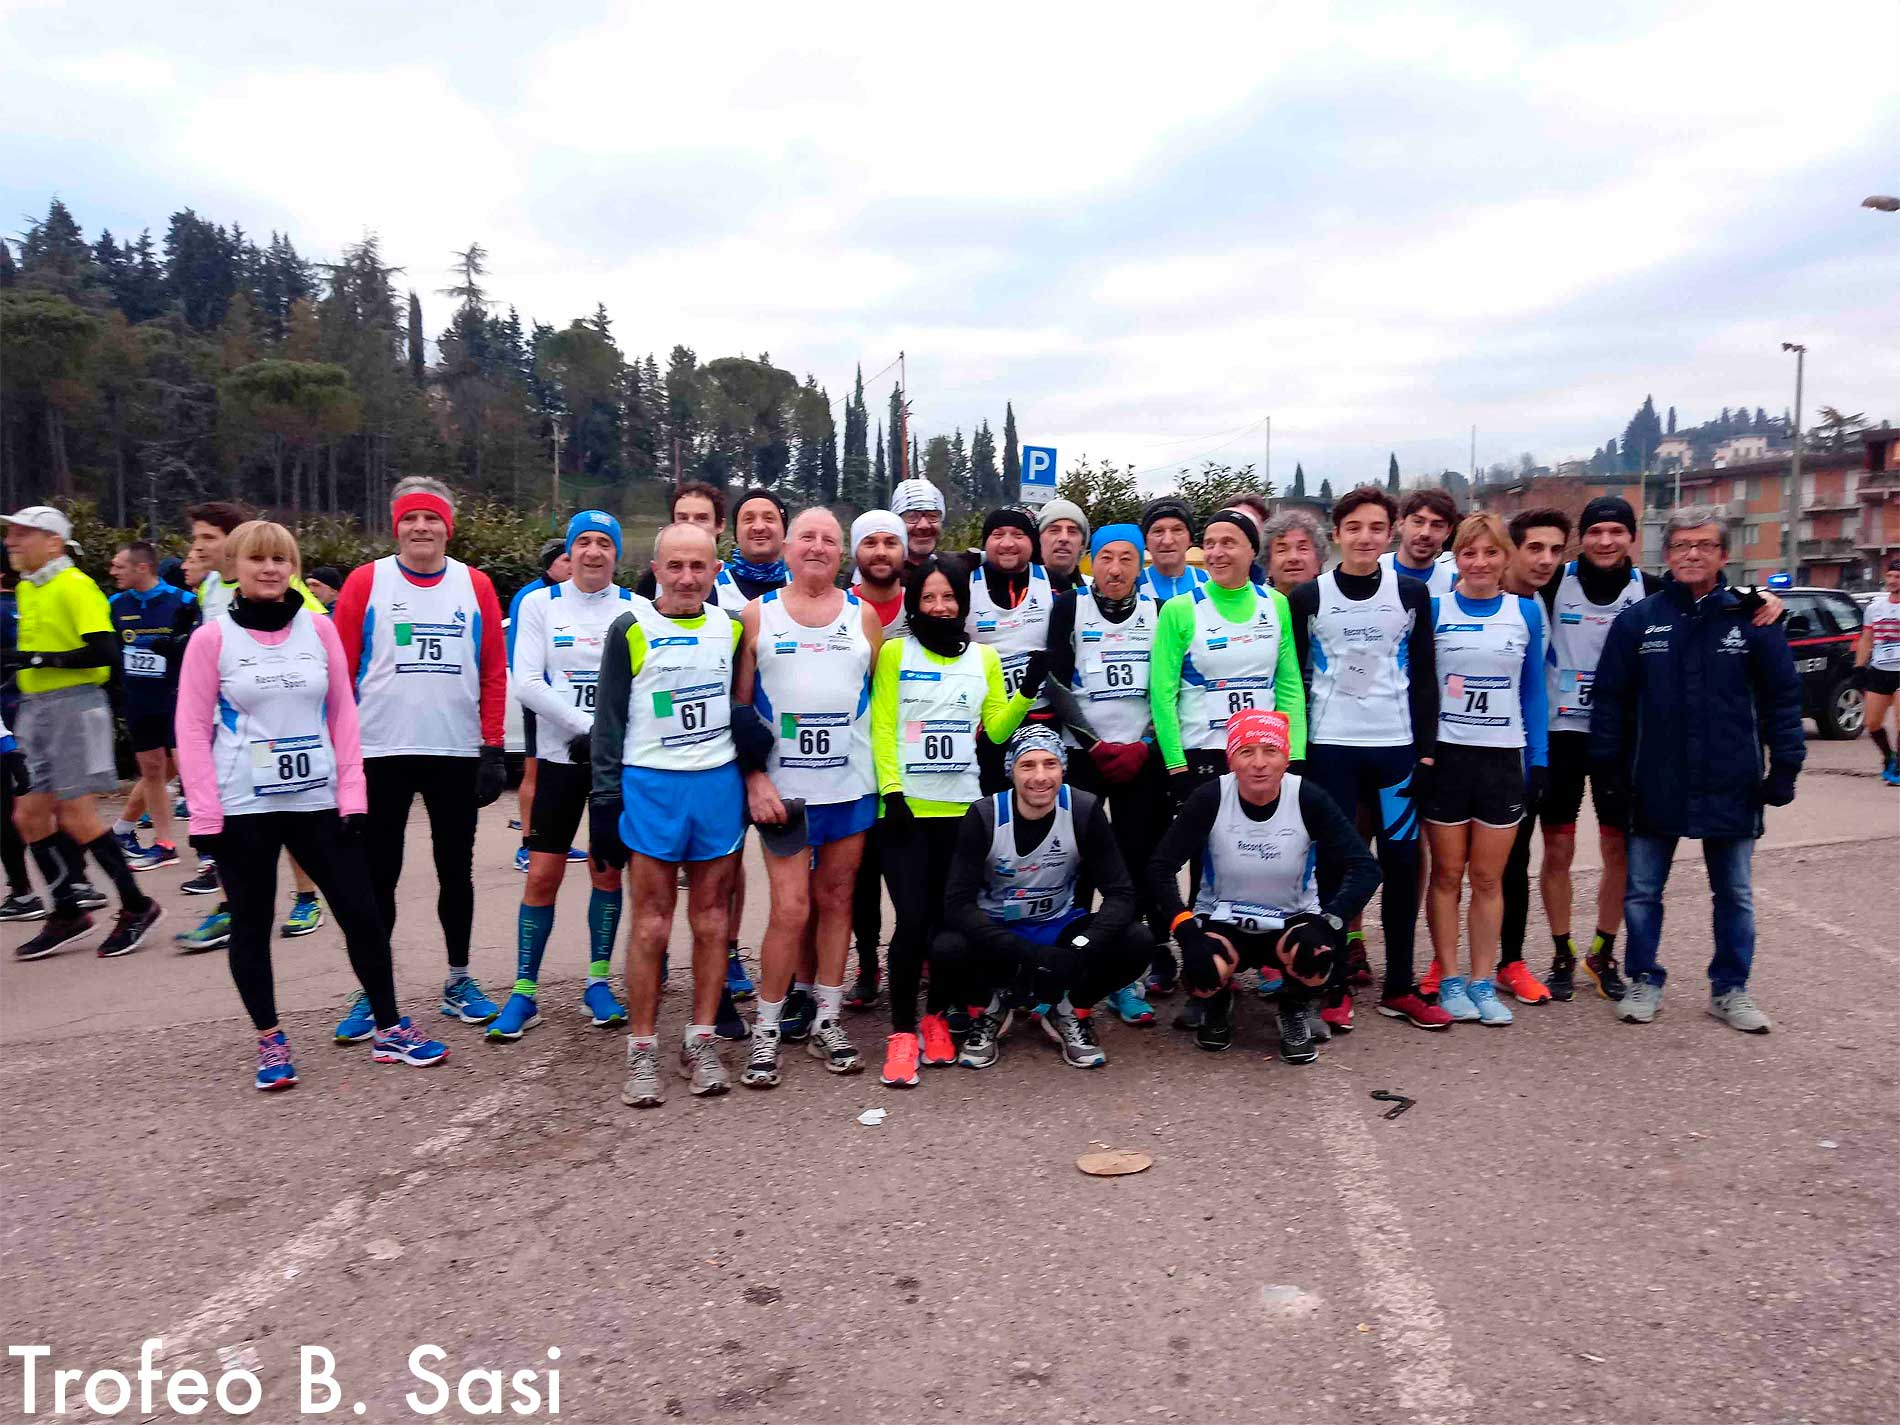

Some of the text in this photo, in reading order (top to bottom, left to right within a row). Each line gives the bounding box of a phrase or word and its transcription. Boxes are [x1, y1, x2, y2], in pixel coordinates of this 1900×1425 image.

[1028, 451, 1050, 480] P
[416, 638, 442, 661] 75
[1106, 664, 1134, 687] 63
[573, 684, 596, 708] 78
[1228, 691, 1255, 714] 85
[1464, 690, 1489, 714] 74
[681, 702, 706, 731] 67
[799, 729, 830, 755] 66
[925, 734, 953, 760] 60
[278, 752, 310, 780] 80
[1027, 898, 1053, 916] 79
